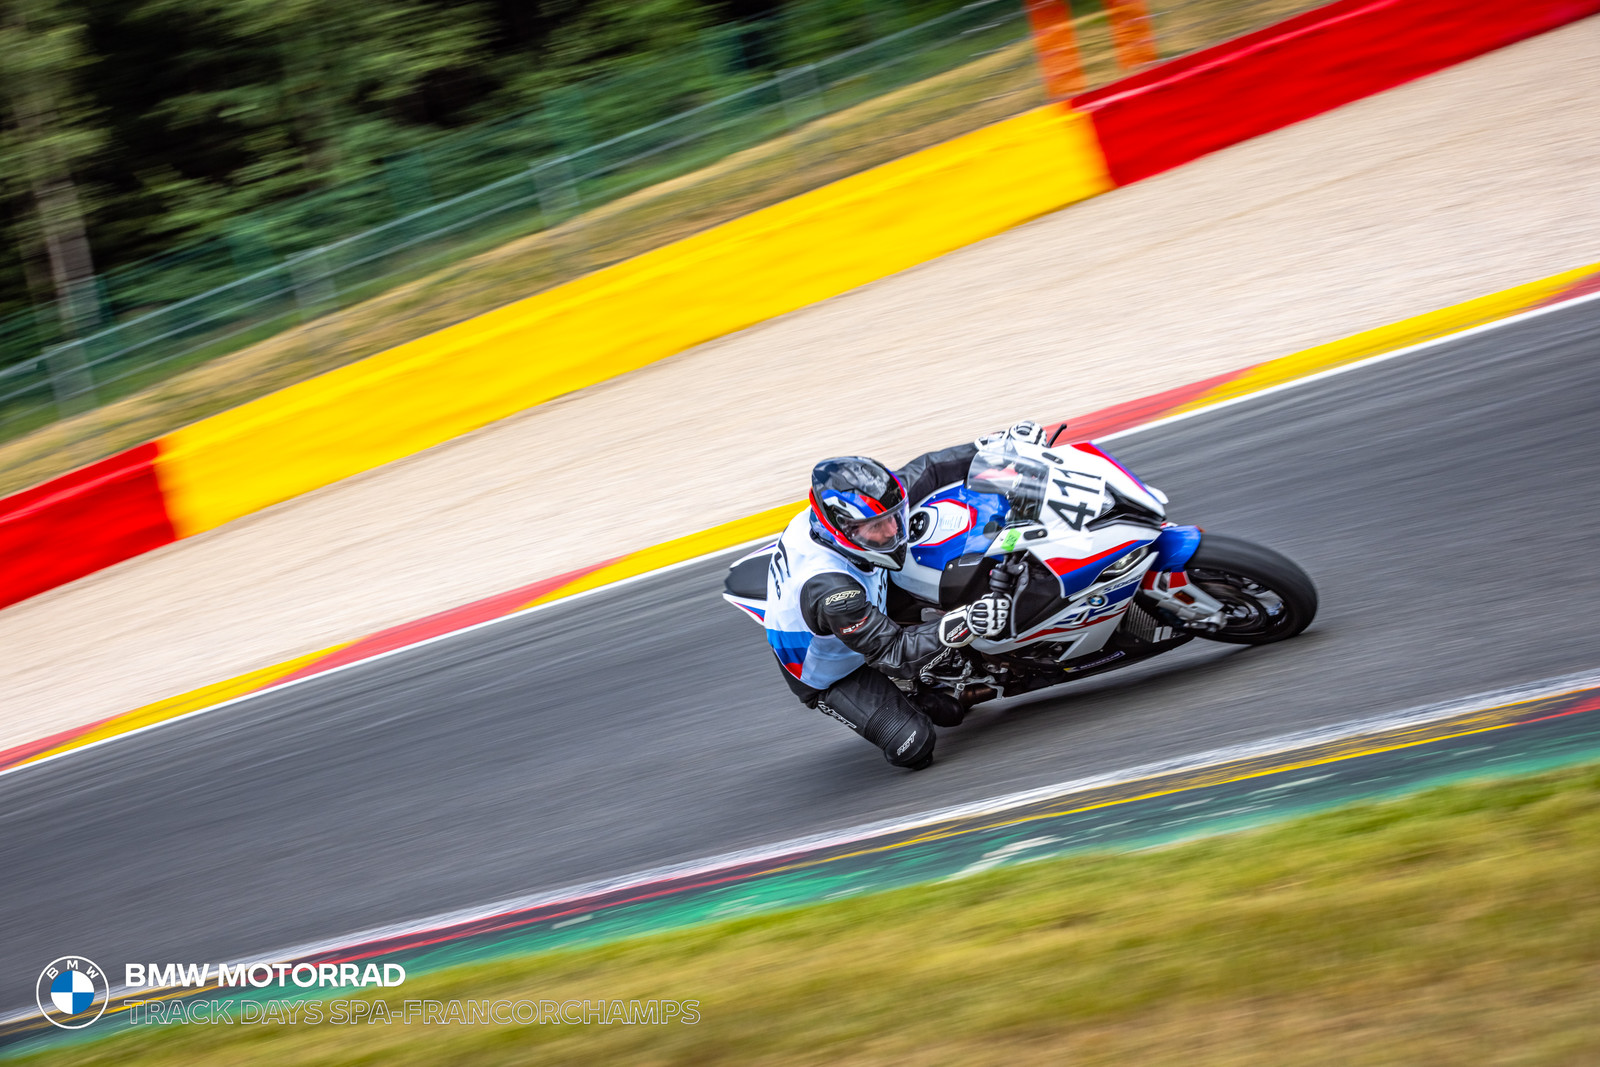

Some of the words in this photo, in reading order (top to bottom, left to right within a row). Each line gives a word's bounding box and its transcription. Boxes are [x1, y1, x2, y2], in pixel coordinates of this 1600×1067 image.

[1046, 466, 1102, 532] 411
[824, 589, 861, 606] RST
[896, 730, 917, 756] RST
